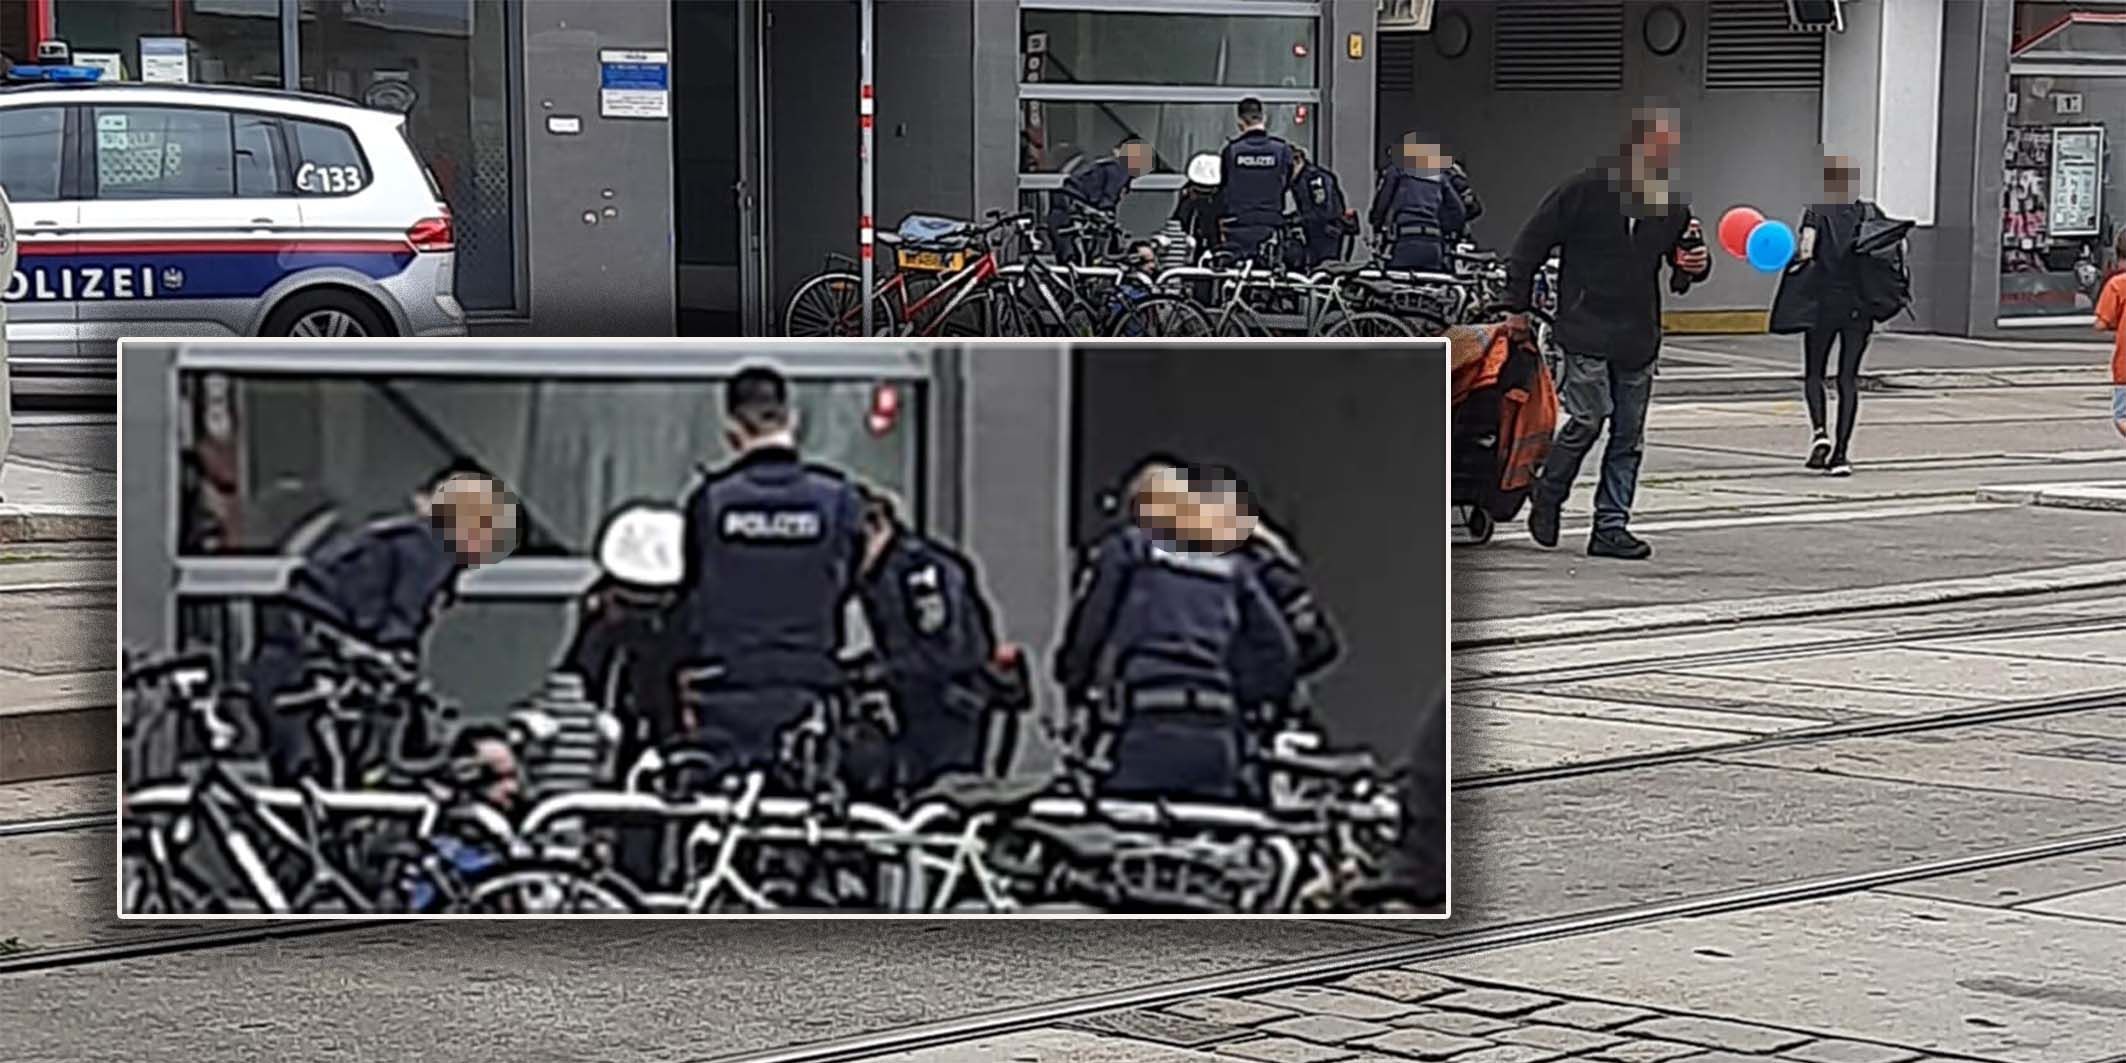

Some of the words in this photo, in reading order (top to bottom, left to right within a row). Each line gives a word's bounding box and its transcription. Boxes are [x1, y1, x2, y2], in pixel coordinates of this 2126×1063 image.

[1236, 154, 1276, 167] POLIZEI
[316, 165, 362, 193] 133
[2, 267, 154, 301] OLIZEI
[724, 511, 820, 539] POLIZEI
